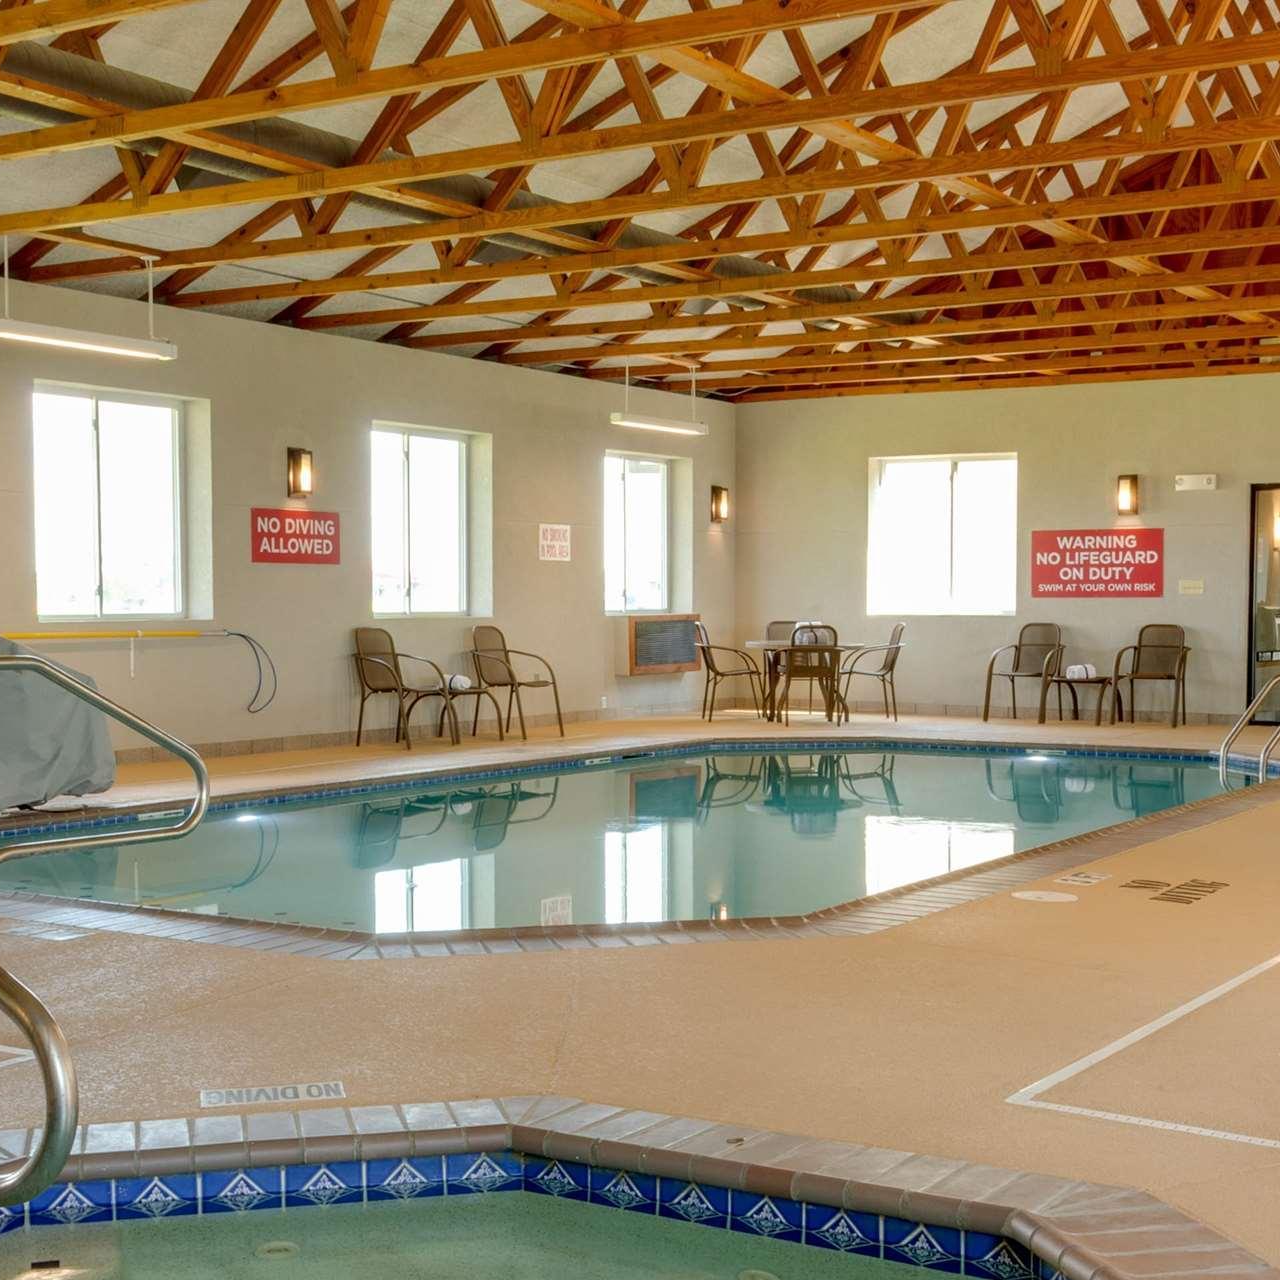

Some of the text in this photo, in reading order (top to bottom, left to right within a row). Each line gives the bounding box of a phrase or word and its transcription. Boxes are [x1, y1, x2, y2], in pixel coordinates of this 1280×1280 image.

[257, 516, 336, 536] NO DIVING
[260, 536, 334, 555] ALLOWED
[1056, 535, 1137, 549] WARNING
[1036, 550, 1159, 565] NO LIFEGUARD
[1059, 566, 1135, 581] ON DUTY
[1038, 582, 1156, 592] SWIM AT YOUR OWN RISK
[205, 1083, 342, 1105] NO DIVING
